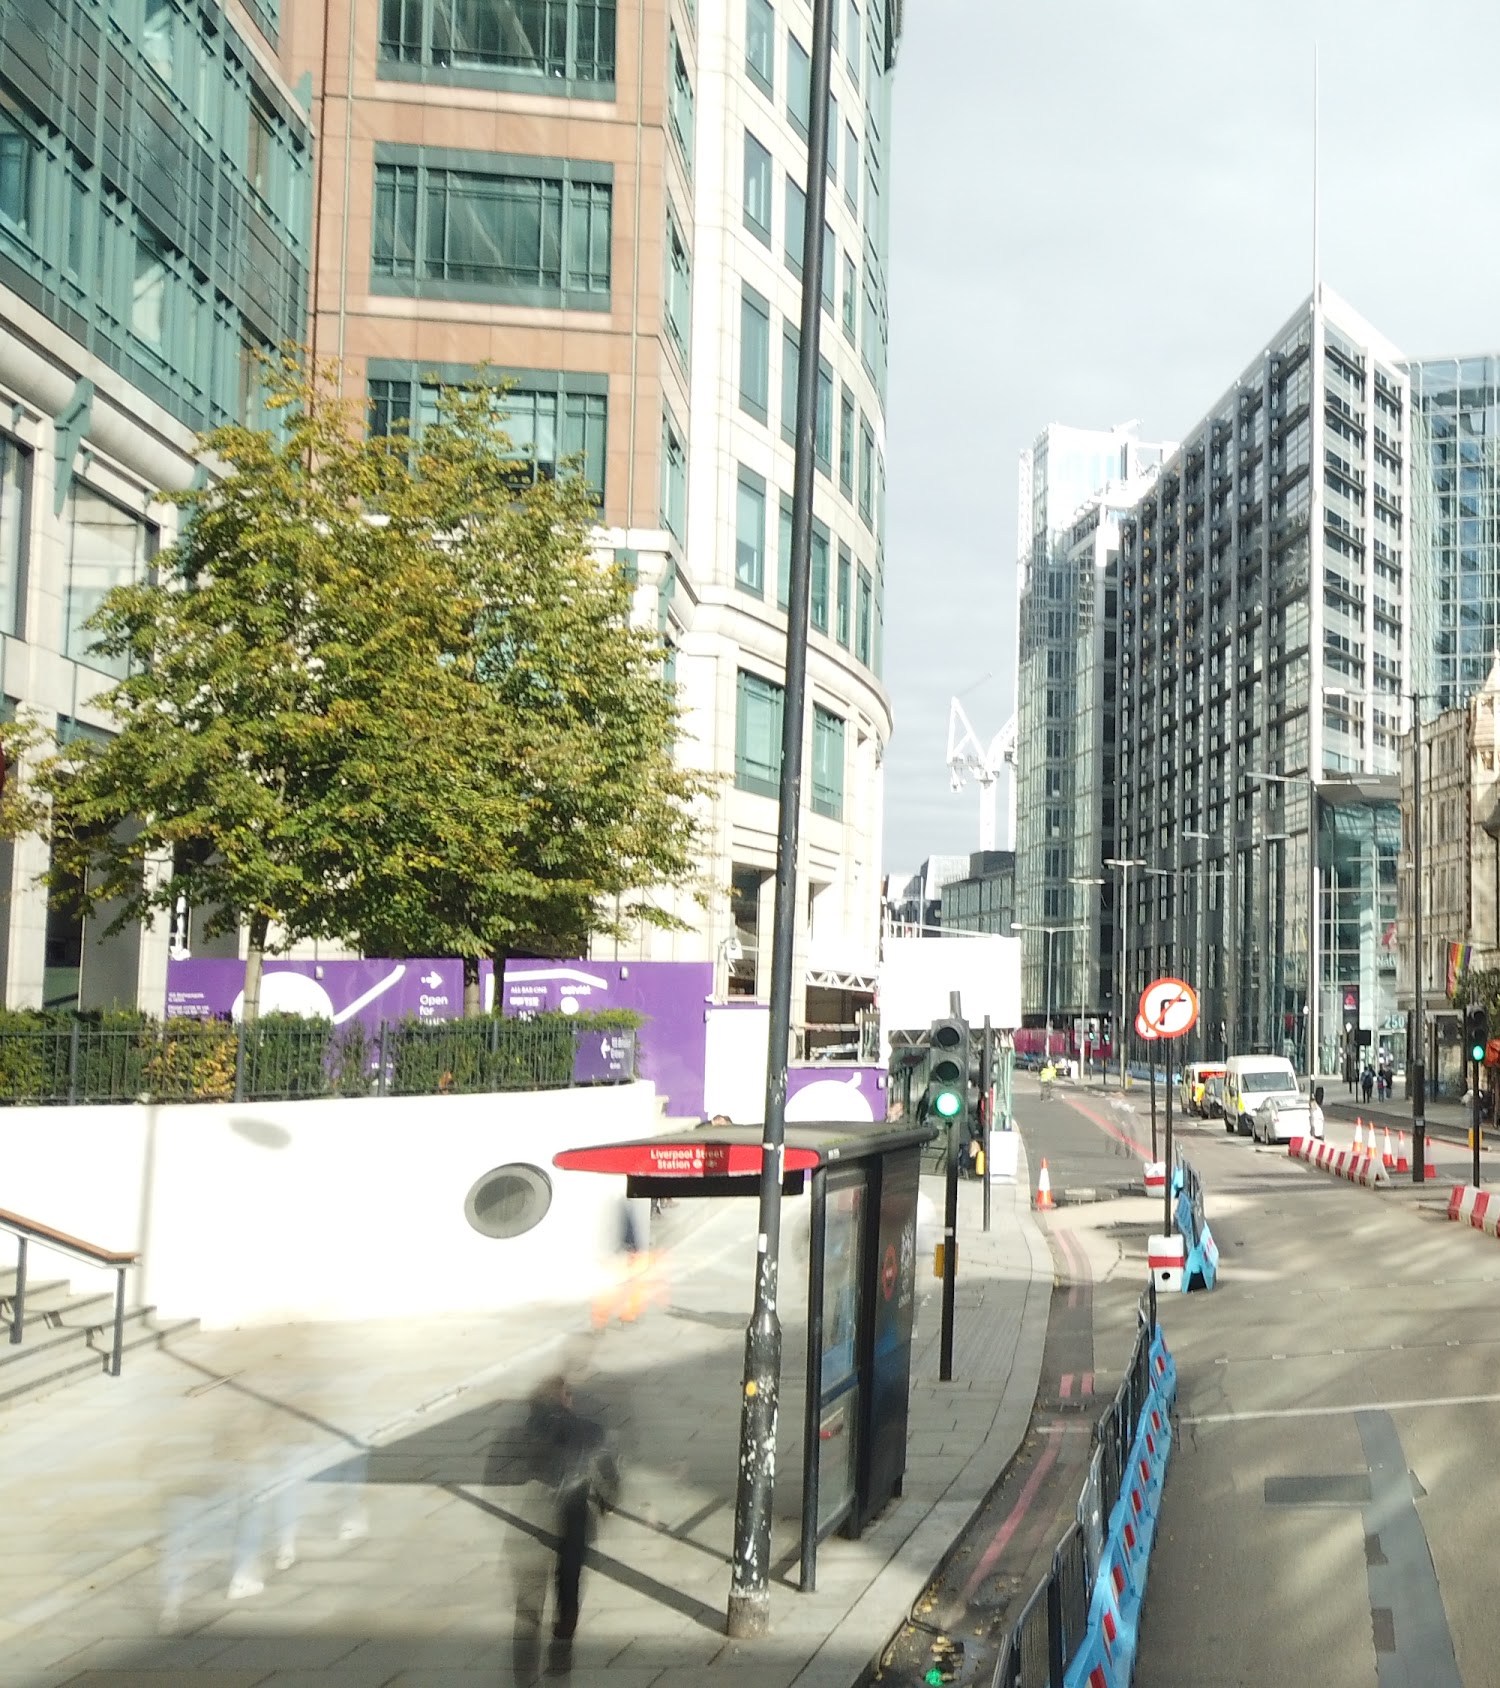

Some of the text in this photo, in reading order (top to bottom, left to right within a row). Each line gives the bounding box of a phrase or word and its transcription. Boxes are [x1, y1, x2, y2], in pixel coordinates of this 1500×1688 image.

[420, 994, 448, 1006] Open
[420, 1005, 434, 1016] for
[1385, 1014, 1405, 1029] 250
[650, 1148, 724, 1160] Liverpool Street
[657, 1159, 690, 1170] Station
